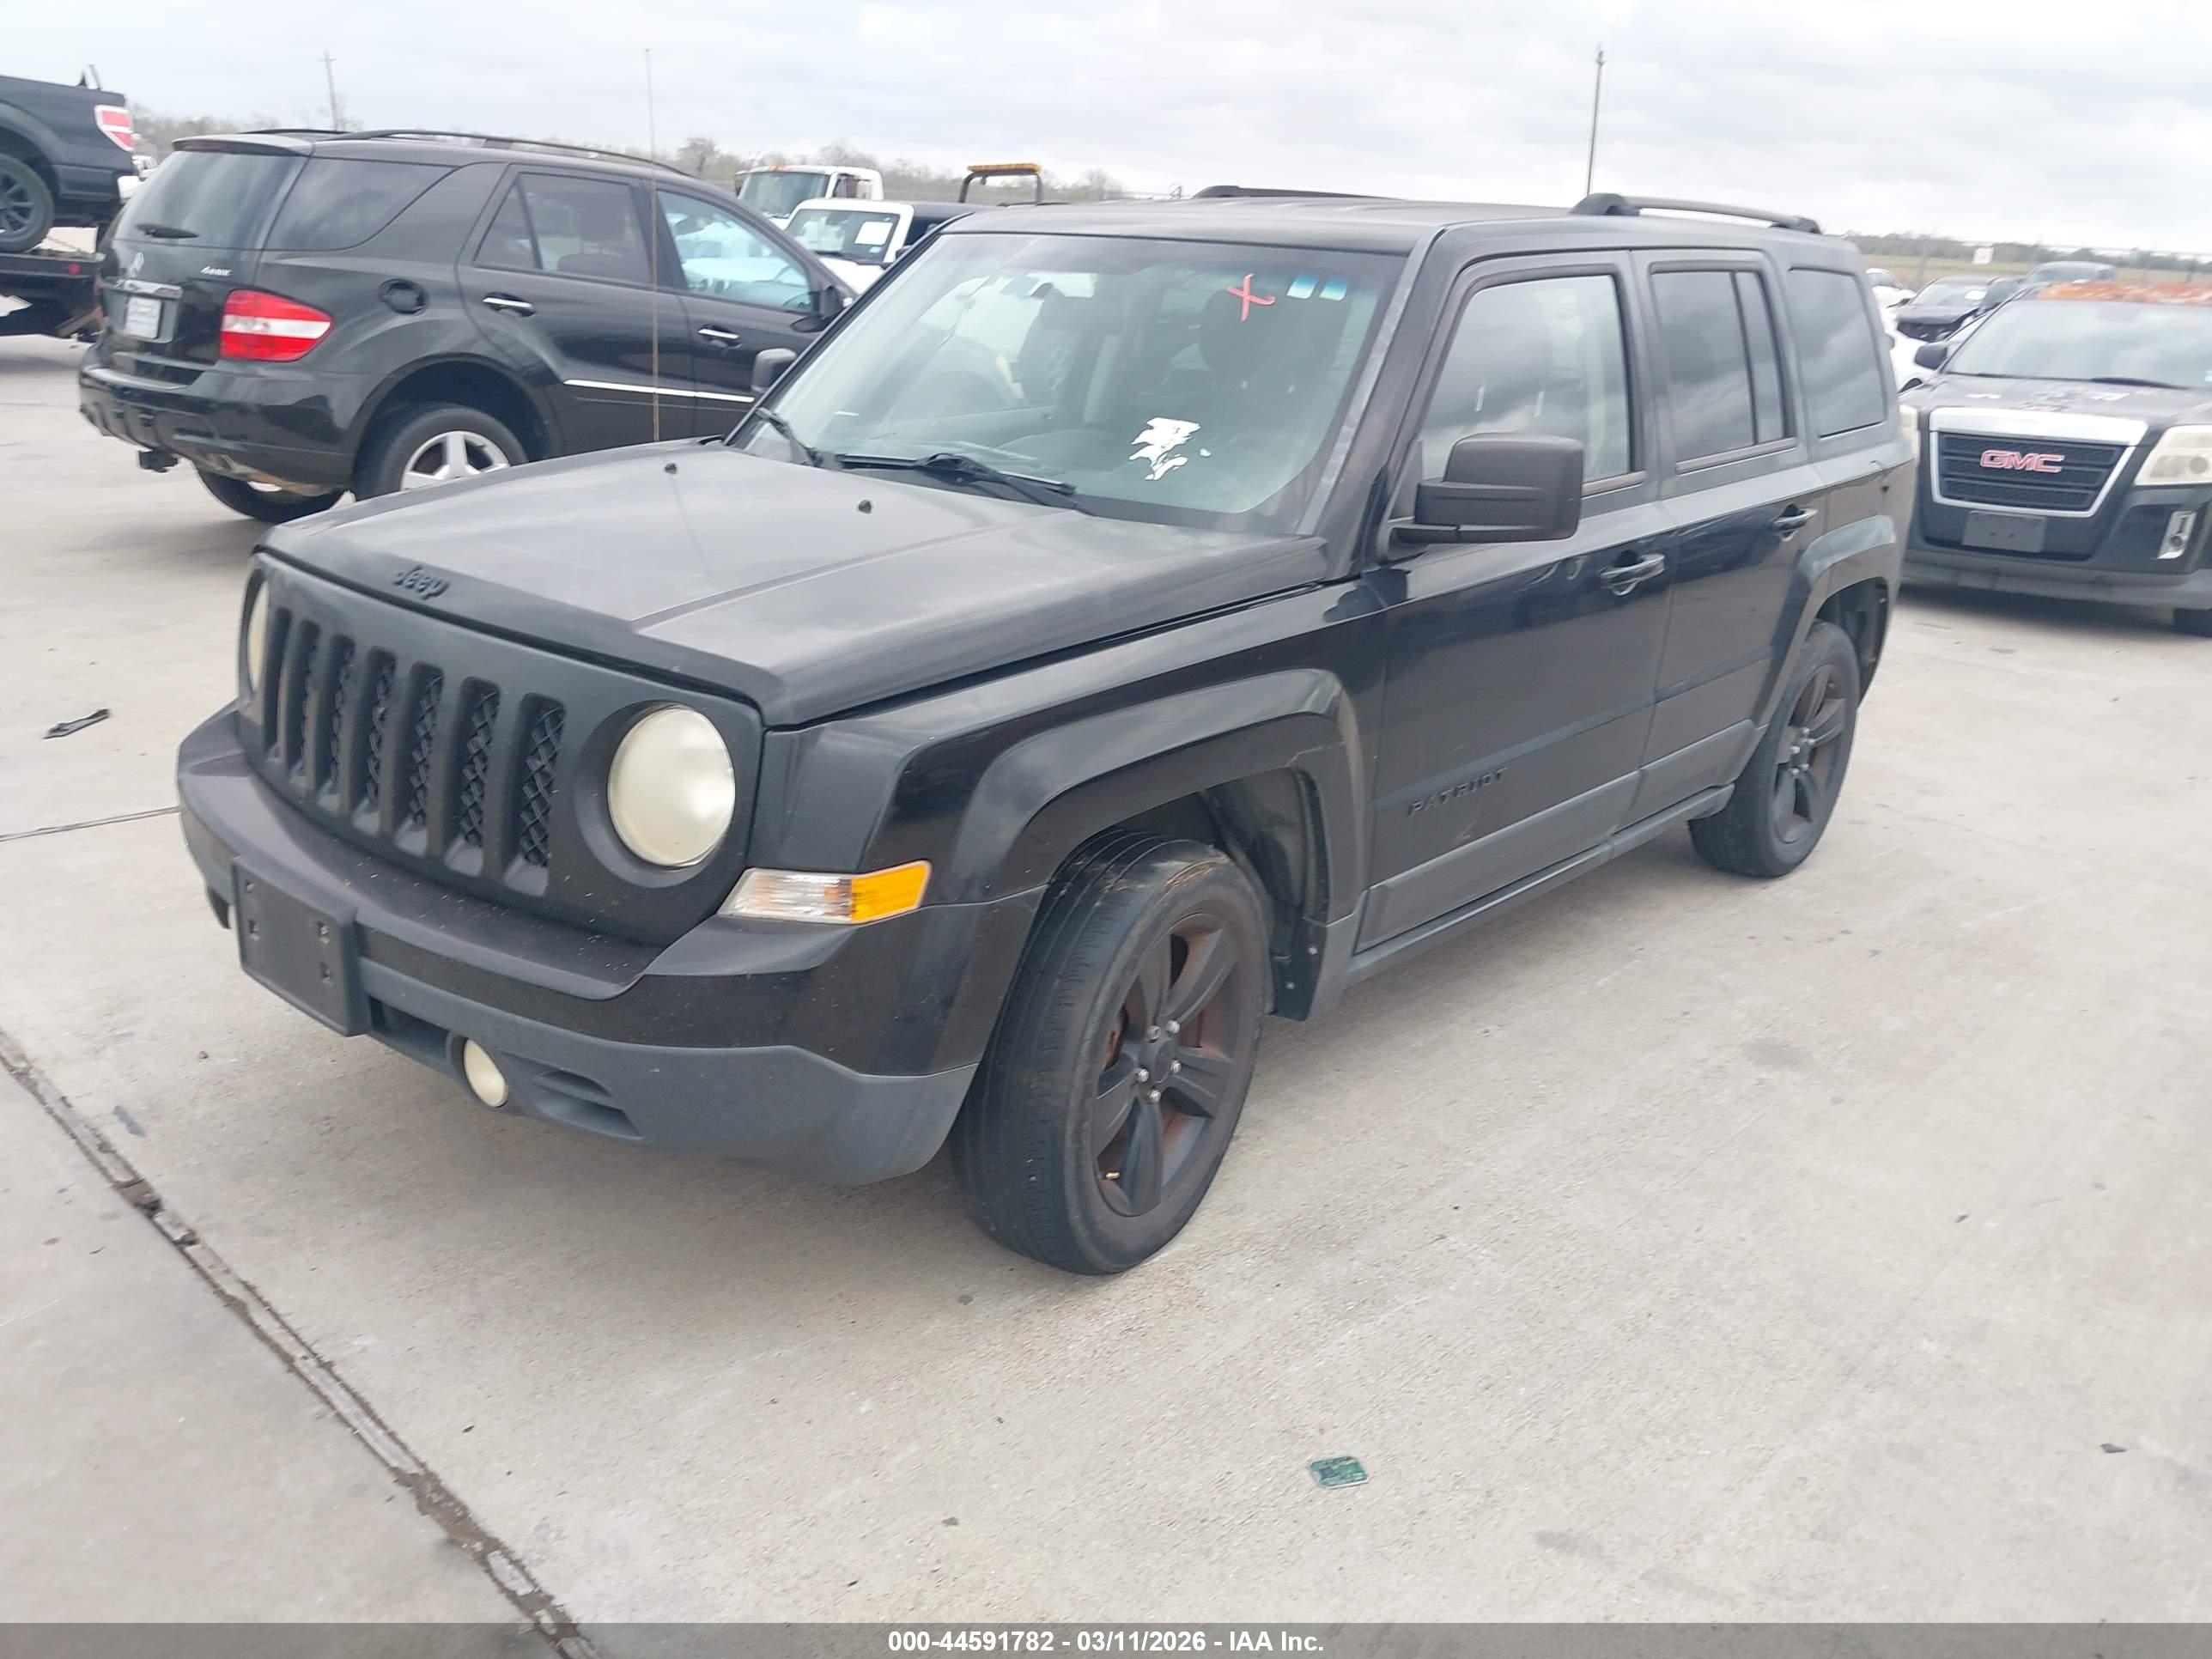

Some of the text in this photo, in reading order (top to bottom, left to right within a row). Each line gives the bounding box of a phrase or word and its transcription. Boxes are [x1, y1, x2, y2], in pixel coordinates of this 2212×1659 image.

[1980, 449, 2064, 473] GMC
[392, 563, 451, 600] Jeep
[1407, 767, 1510, 817] PATRIOT
